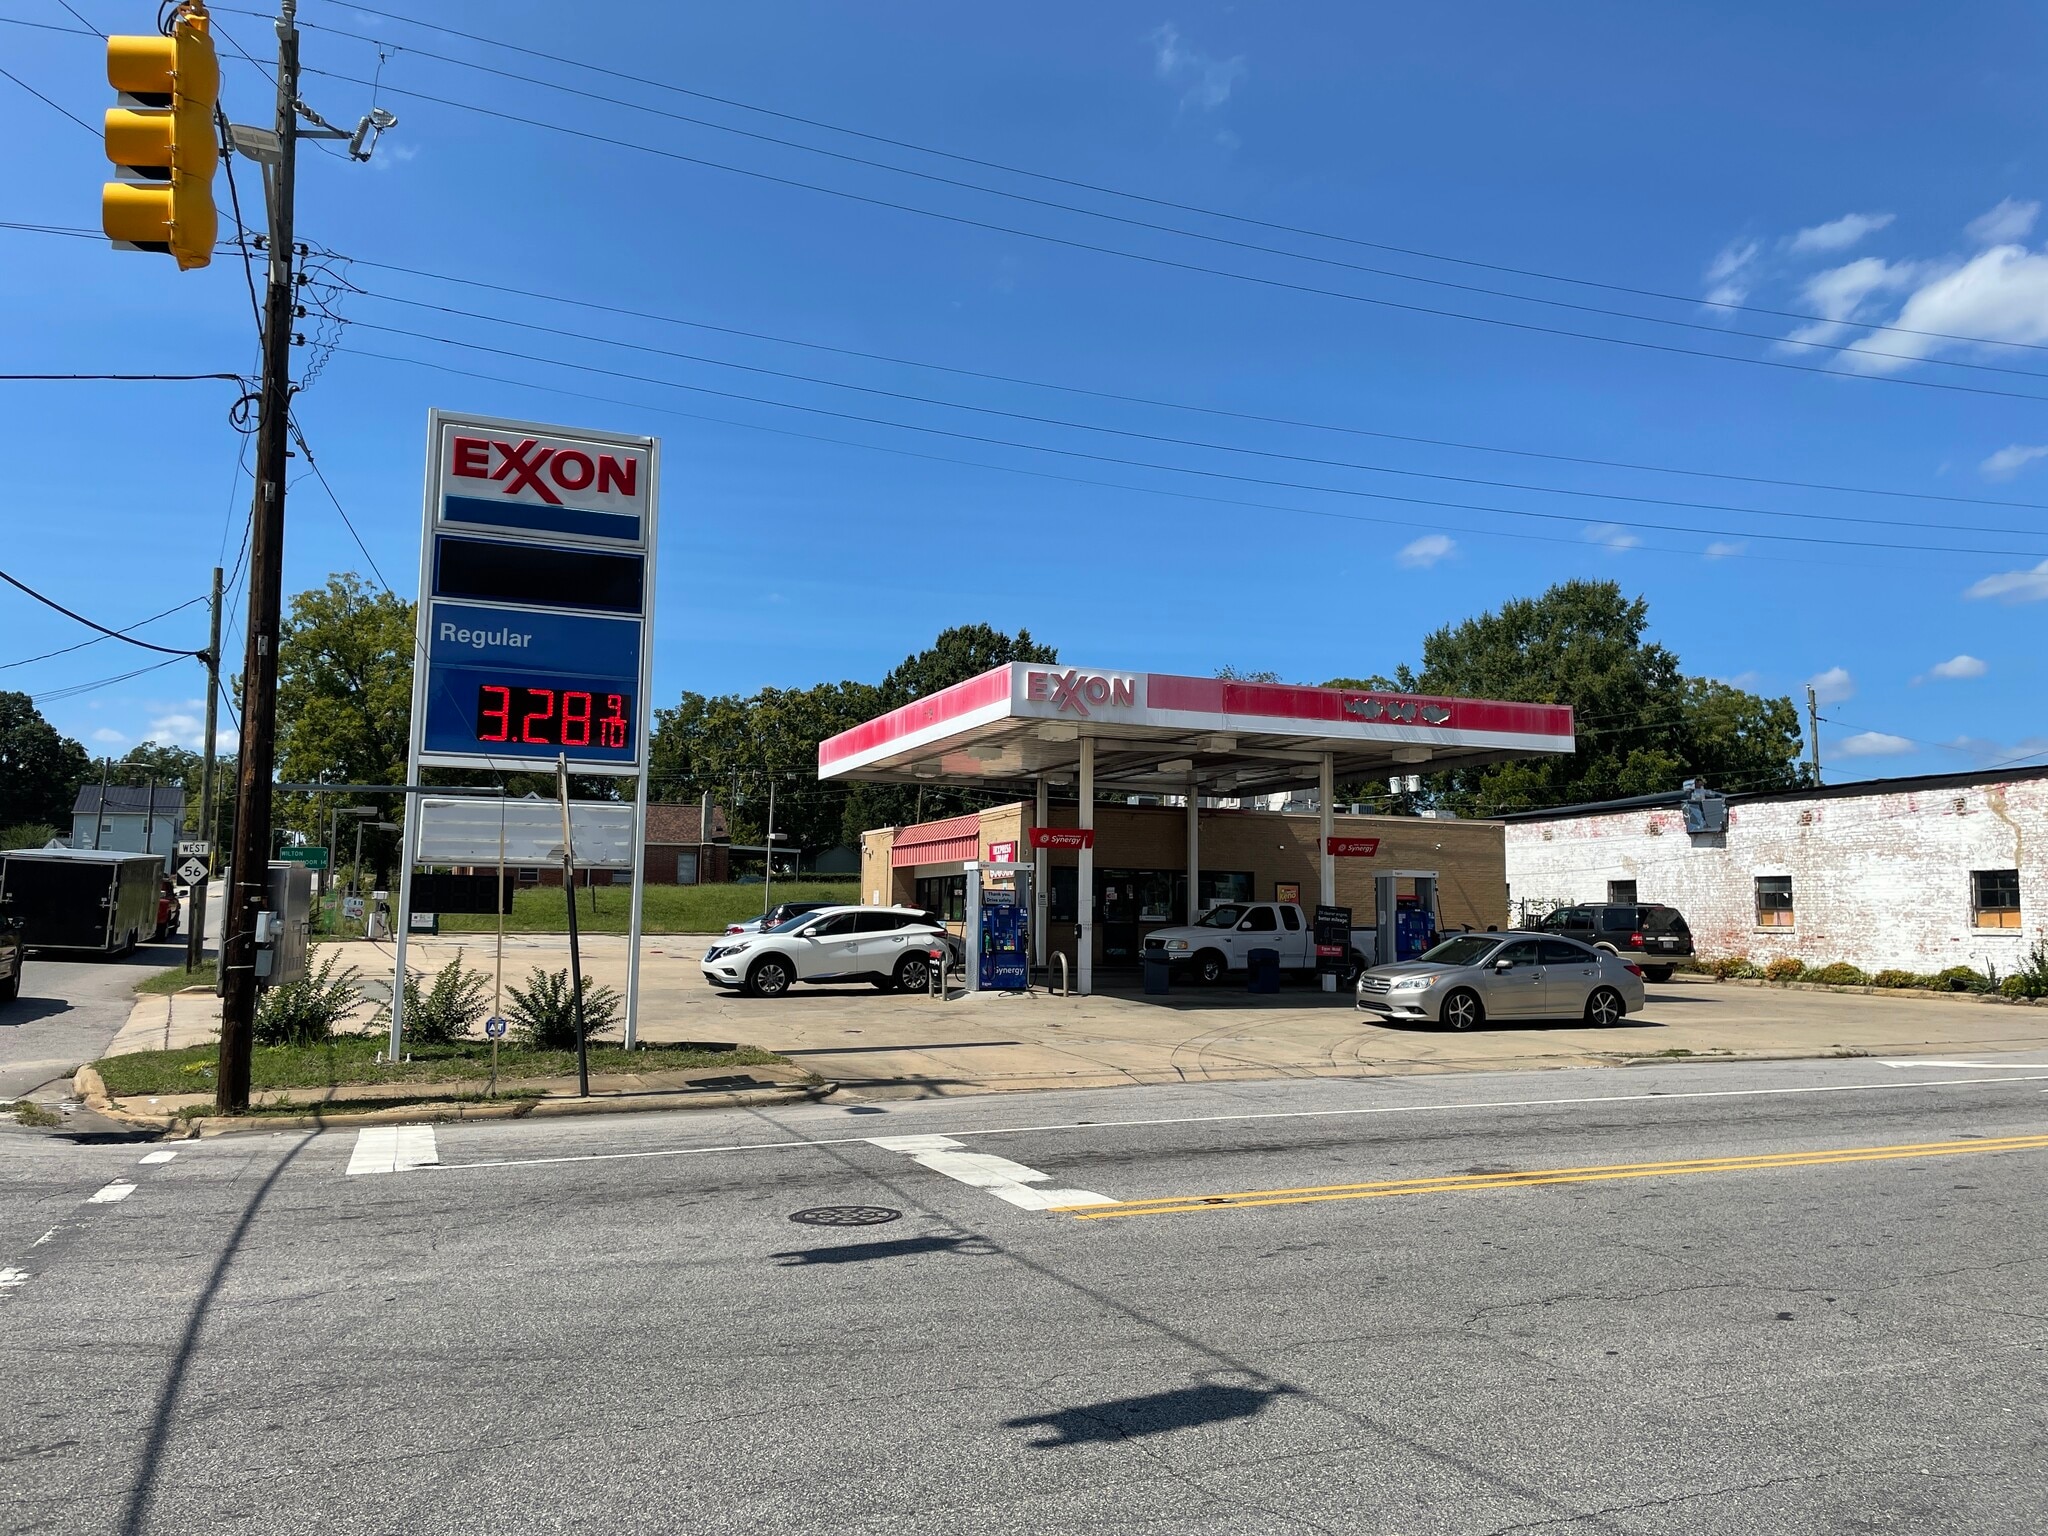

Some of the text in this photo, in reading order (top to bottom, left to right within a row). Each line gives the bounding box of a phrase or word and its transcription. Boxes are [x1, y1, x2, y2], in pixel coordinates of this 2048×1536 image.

[452, 435, 637, 505] EXXON
[440, 622, 532, 649] Regular
[1026, 669, 1136, 716] EXXON
[479, 685, 592, 746] 3.28
[1051, 835, 1081, 845] Synergy
[183, 844, 205, 853] WEST
[1348, 844, 1374, 853] Synergy
[184, 866, 201, 877] 56
[488, 1023, 504, 1031] AT
